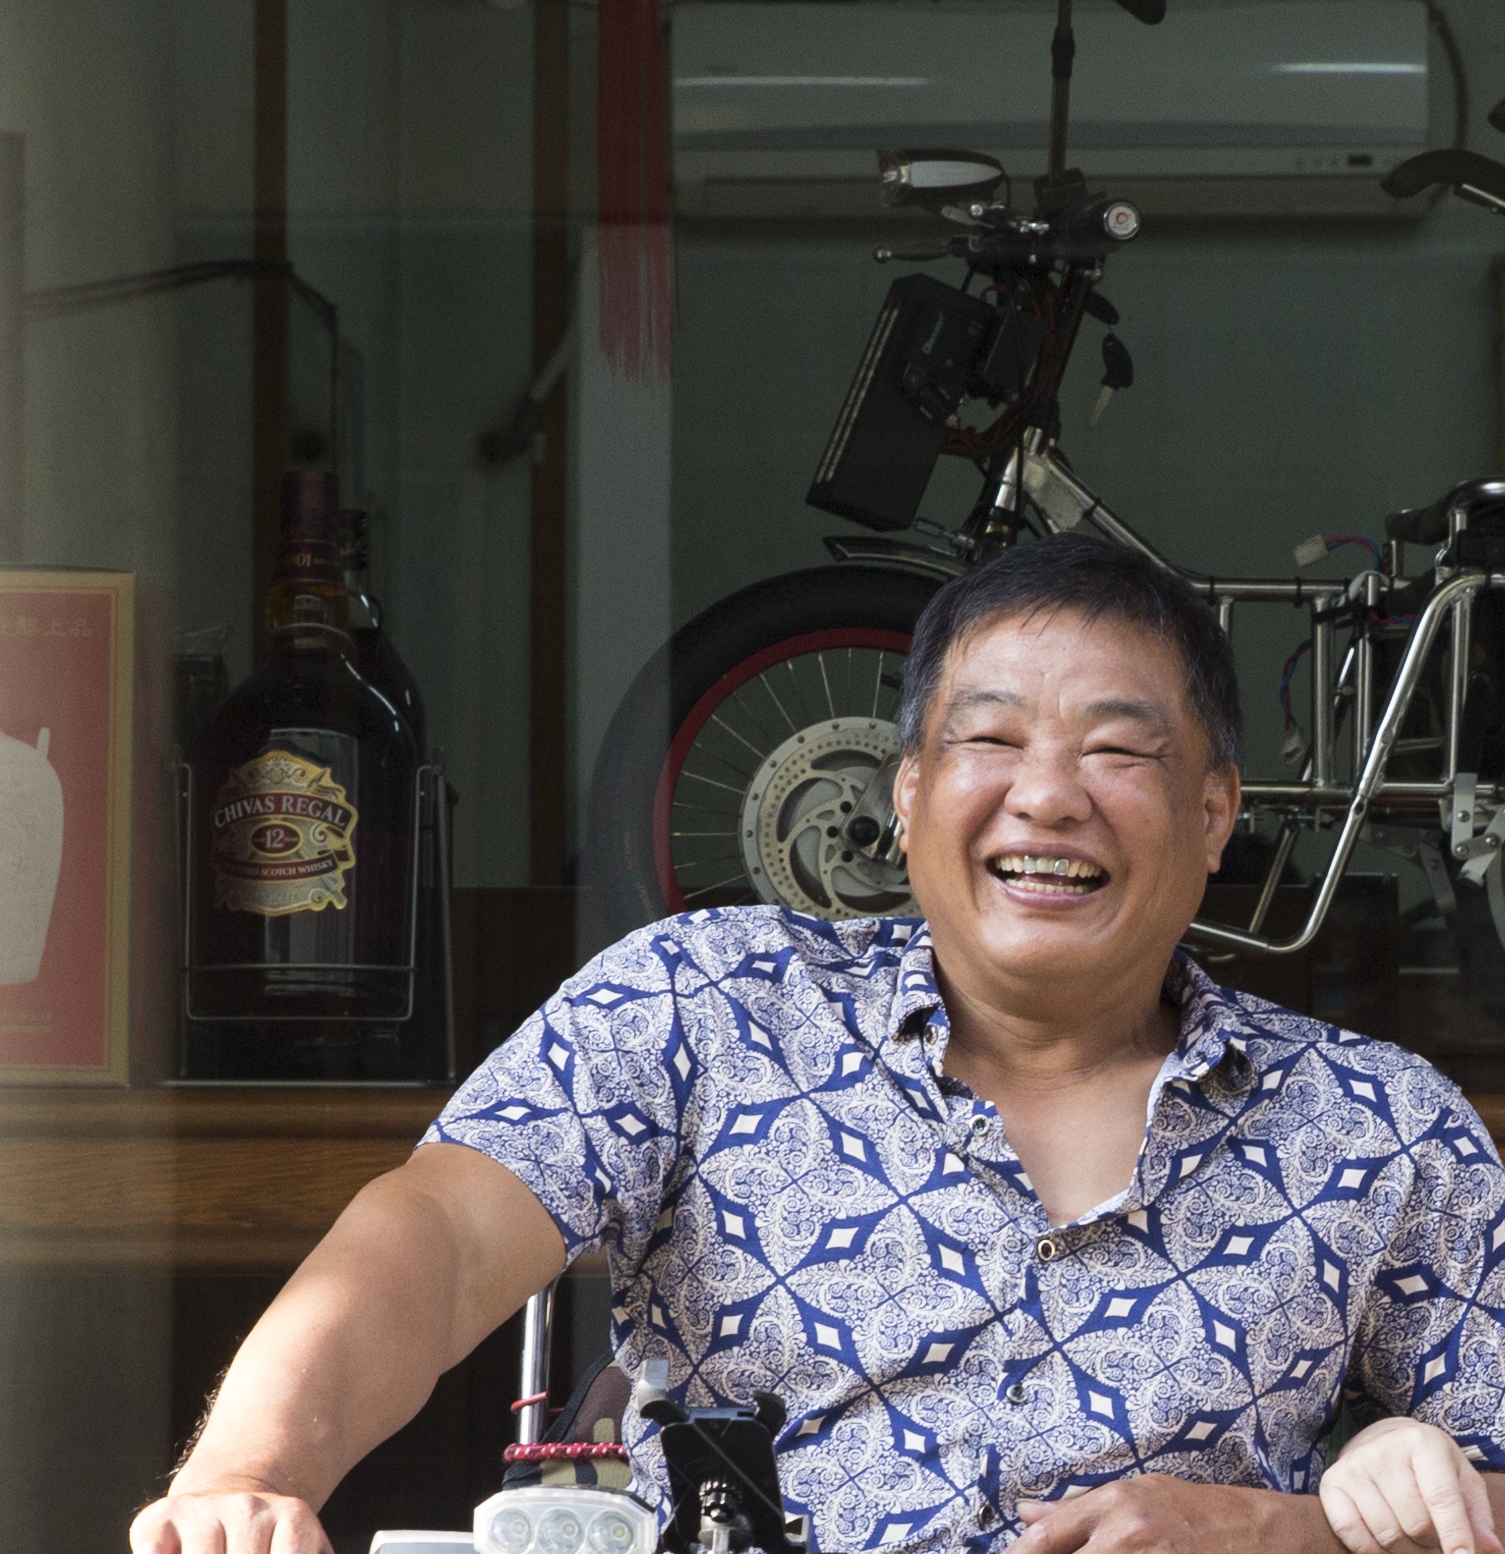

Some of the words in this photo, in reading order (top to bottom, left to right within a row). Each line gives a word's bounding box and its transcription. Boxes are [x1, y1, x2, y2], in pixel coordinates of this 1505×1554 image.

[214, 795, 275, 828] CHIVAS
[281, 795, 345, 827] REGAL
[264, 828, 285, 848] 12
[260, 868, 296, 877] SCOTCH
[298, 860, 334, 874] WHISKY
